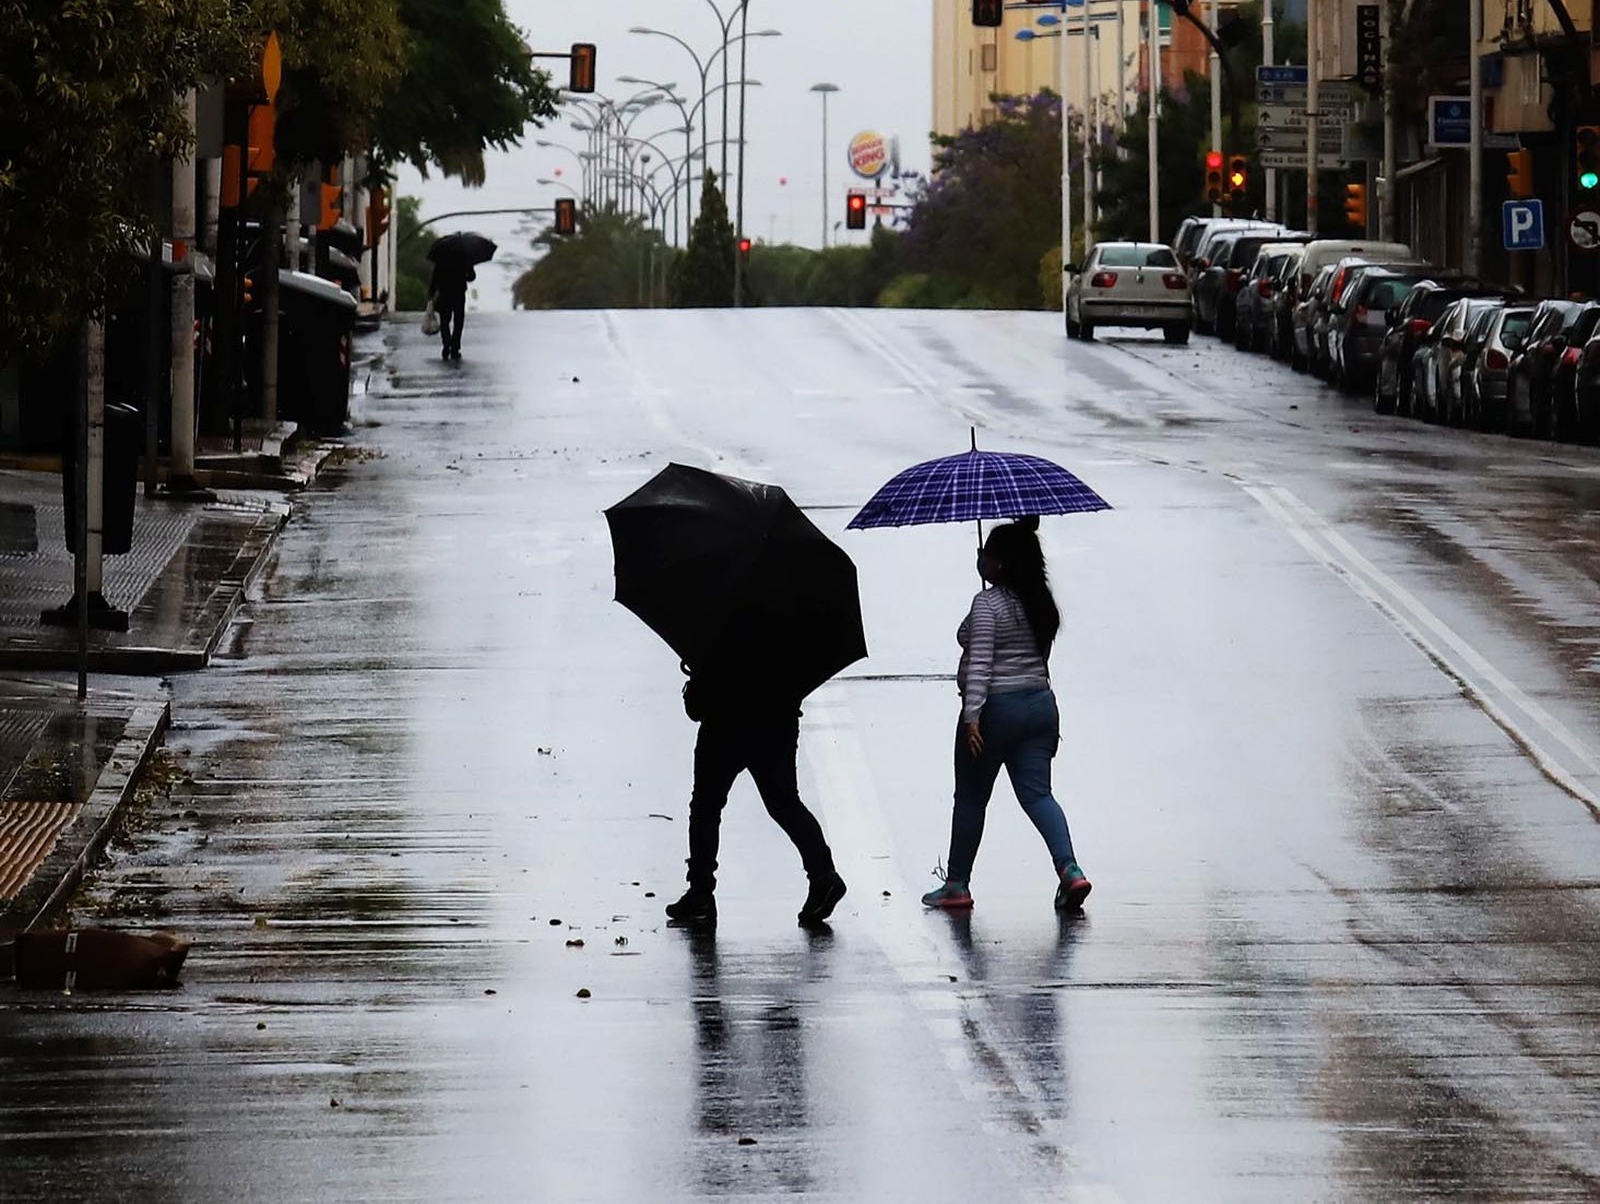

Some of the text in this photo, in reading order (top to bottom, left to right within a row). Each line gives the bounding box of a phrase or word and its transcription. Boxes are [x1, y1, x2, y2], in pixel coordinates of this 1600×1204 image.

[1363, 7, 1377, 84] COCINAS
[852, 147, 885, 167] KING
[1511, 207, 1533, 244] P
